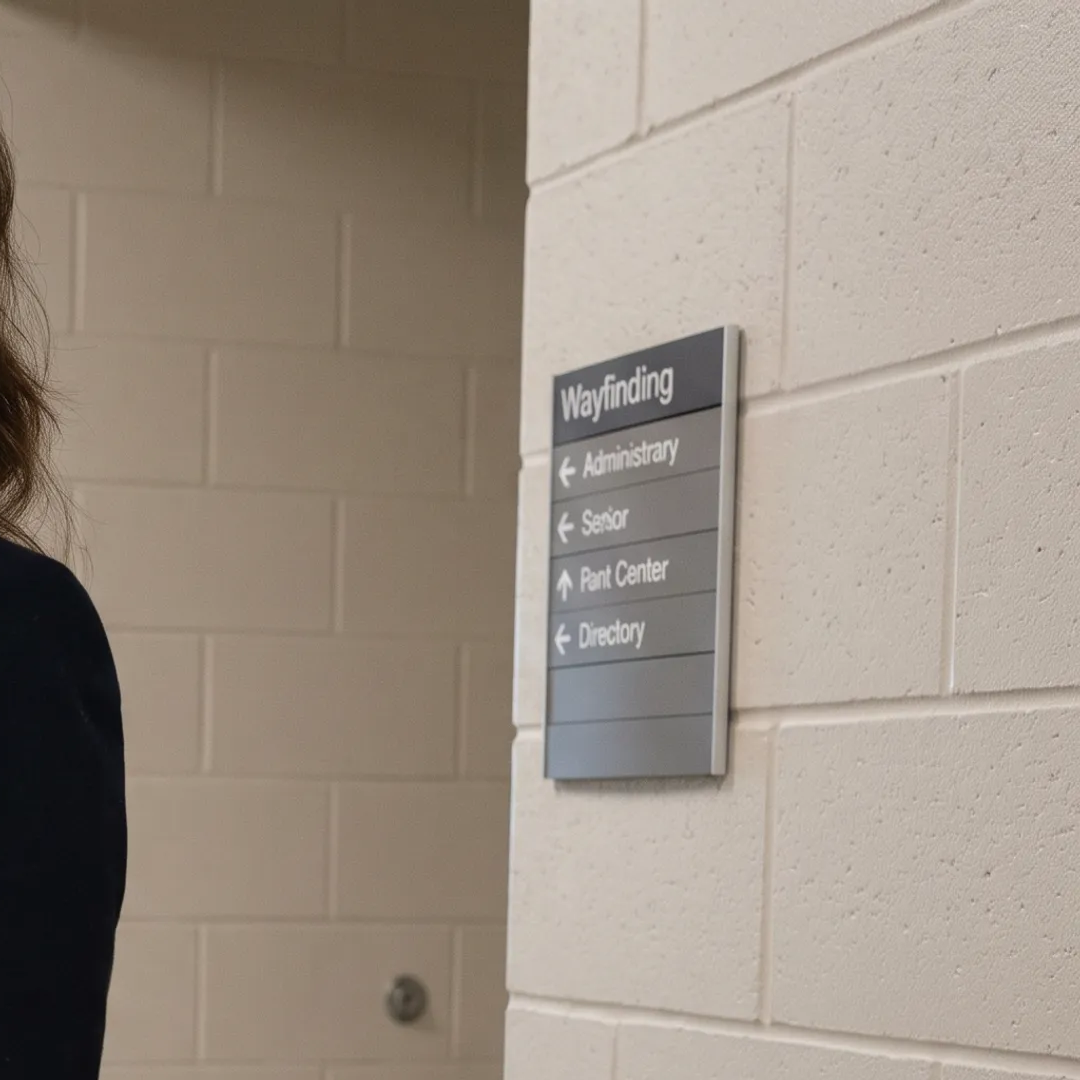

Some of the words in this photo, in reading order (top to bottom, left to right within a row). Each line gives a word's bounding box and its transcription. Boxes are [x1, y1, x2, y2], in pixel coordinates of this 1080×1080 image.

[561, 365, 674, 423] Wayfinding
[615, 557, 670, 588] Center
[579, 619, 646, 650] Directory
